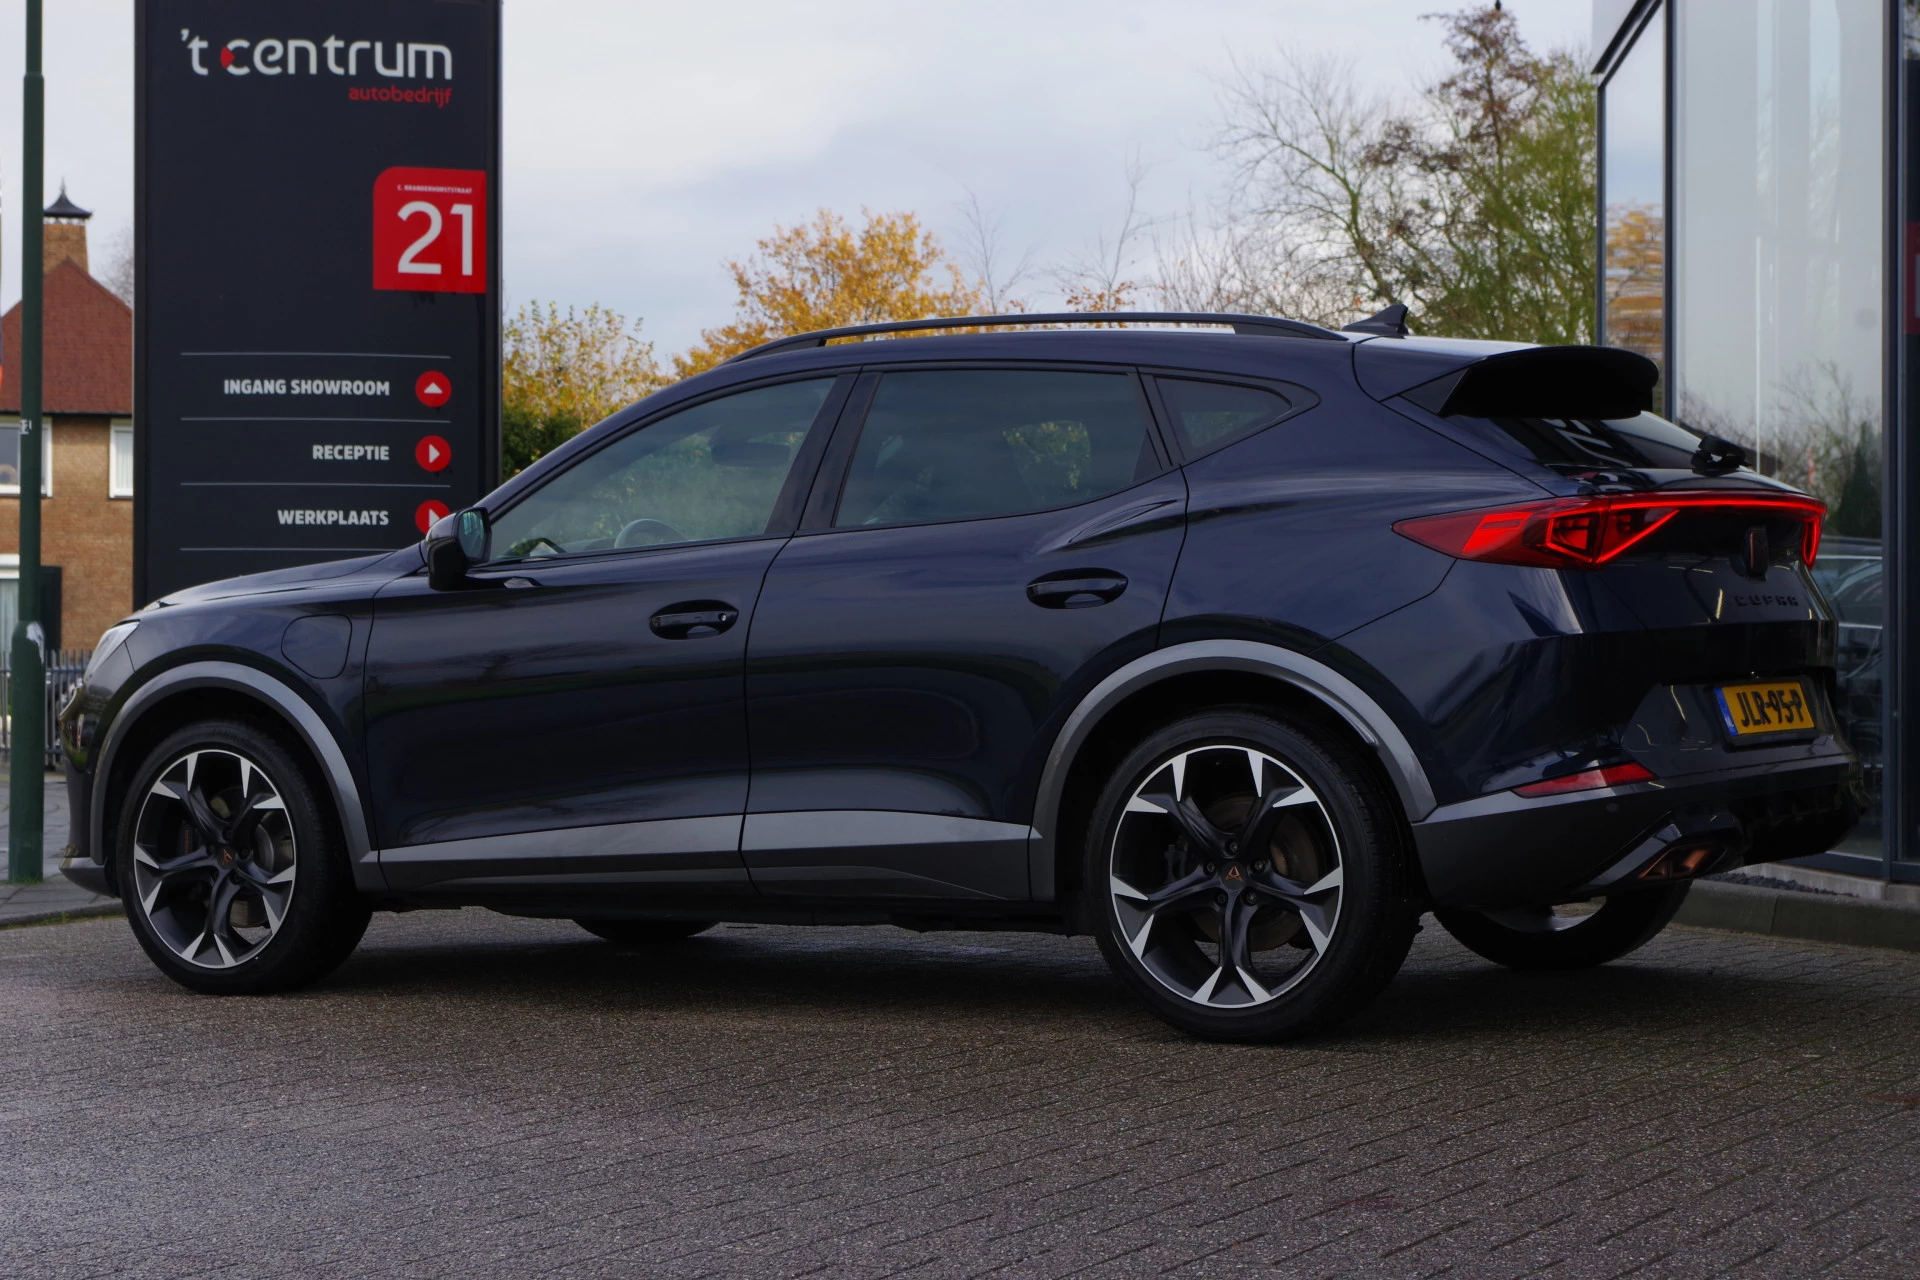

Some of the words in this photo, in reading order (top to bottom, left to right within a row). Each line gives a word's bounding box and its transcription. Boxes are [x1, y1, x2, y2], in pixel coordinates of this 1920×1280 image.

[180, 29, 208, 76] 't
[219, 35, 453, 80] centrum
[348, 85, 453, 108] autobedrijf
[397, 200, 473, 276] 21
[224, 379, 287, 395] INGANG
[290, 379, 390, 396] SHOWROOM
[312, 445, 390, 461] RECEPTIE
[277, 509, 390, 526] WERKPLAATS
[1736, 689, 1803, 727] JLR-95-P
